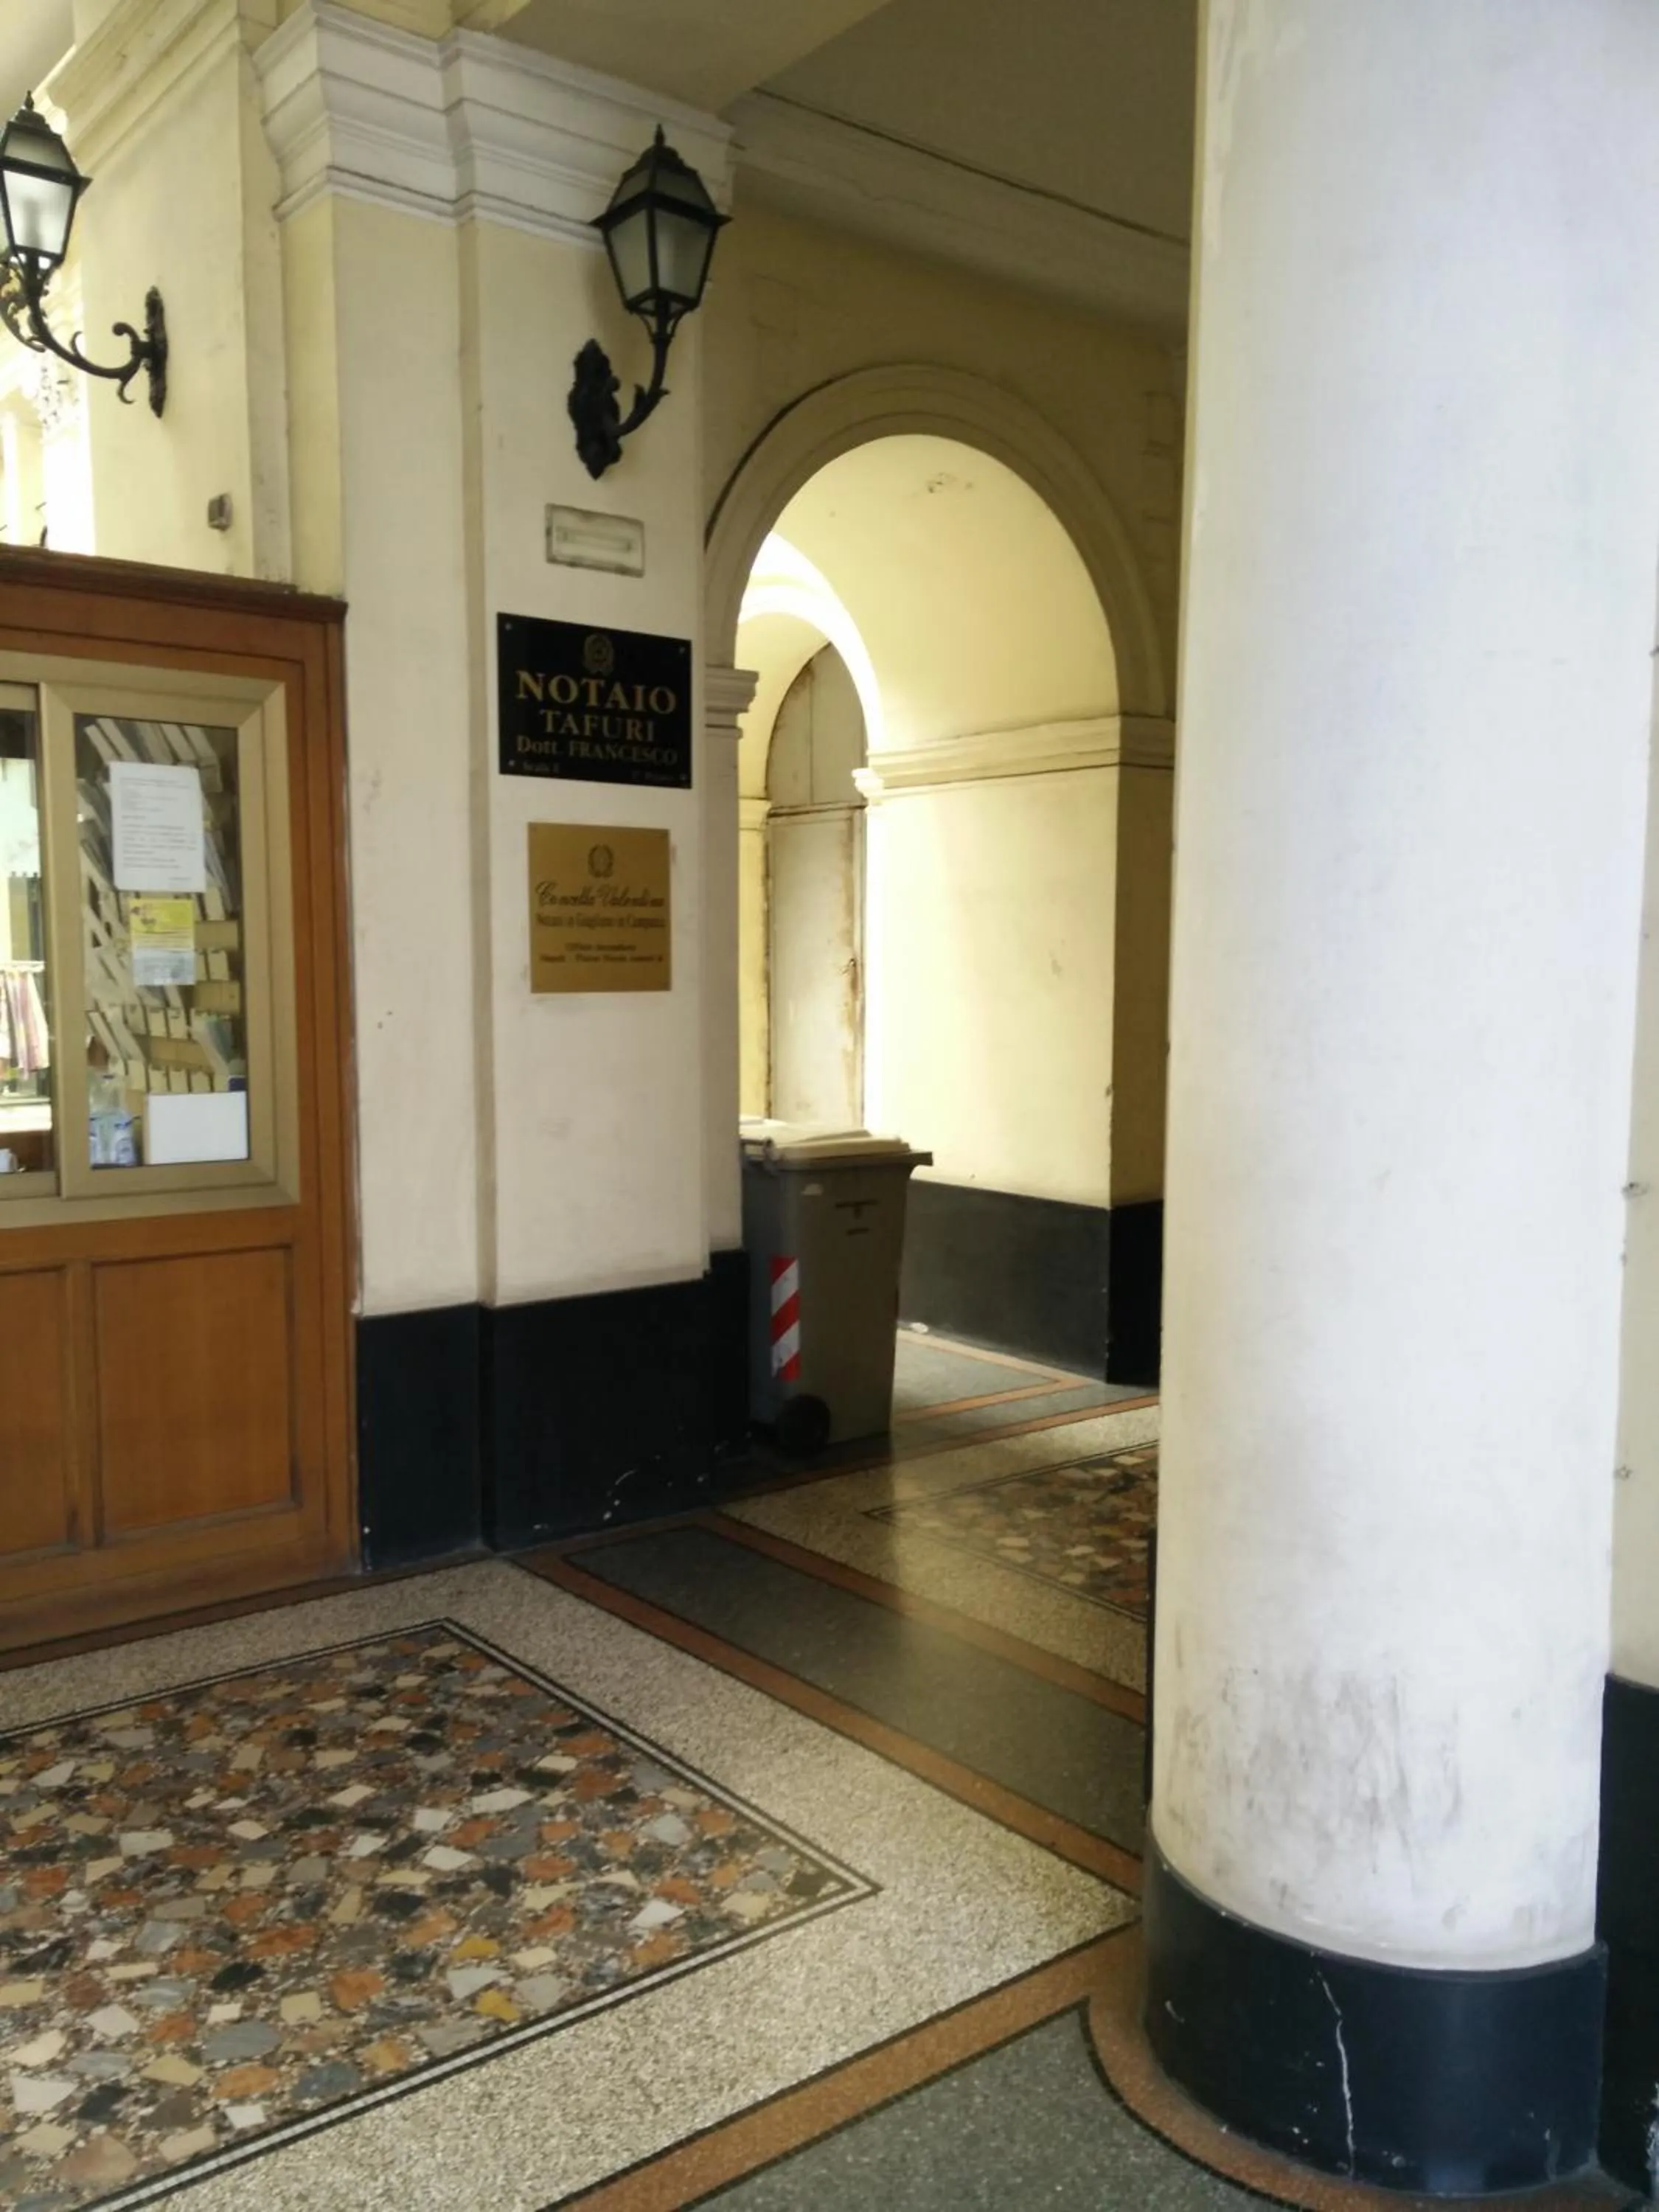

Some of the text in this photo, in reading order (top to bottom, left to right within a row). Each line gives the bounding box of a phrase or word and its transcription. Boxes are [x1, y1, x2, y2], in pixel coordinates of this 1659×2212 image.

[515, 669, 677, 715] NOTAIO
[539, 709, 655, 742] TAFURI
[568, 739, 678, 765] FRANCESCO
